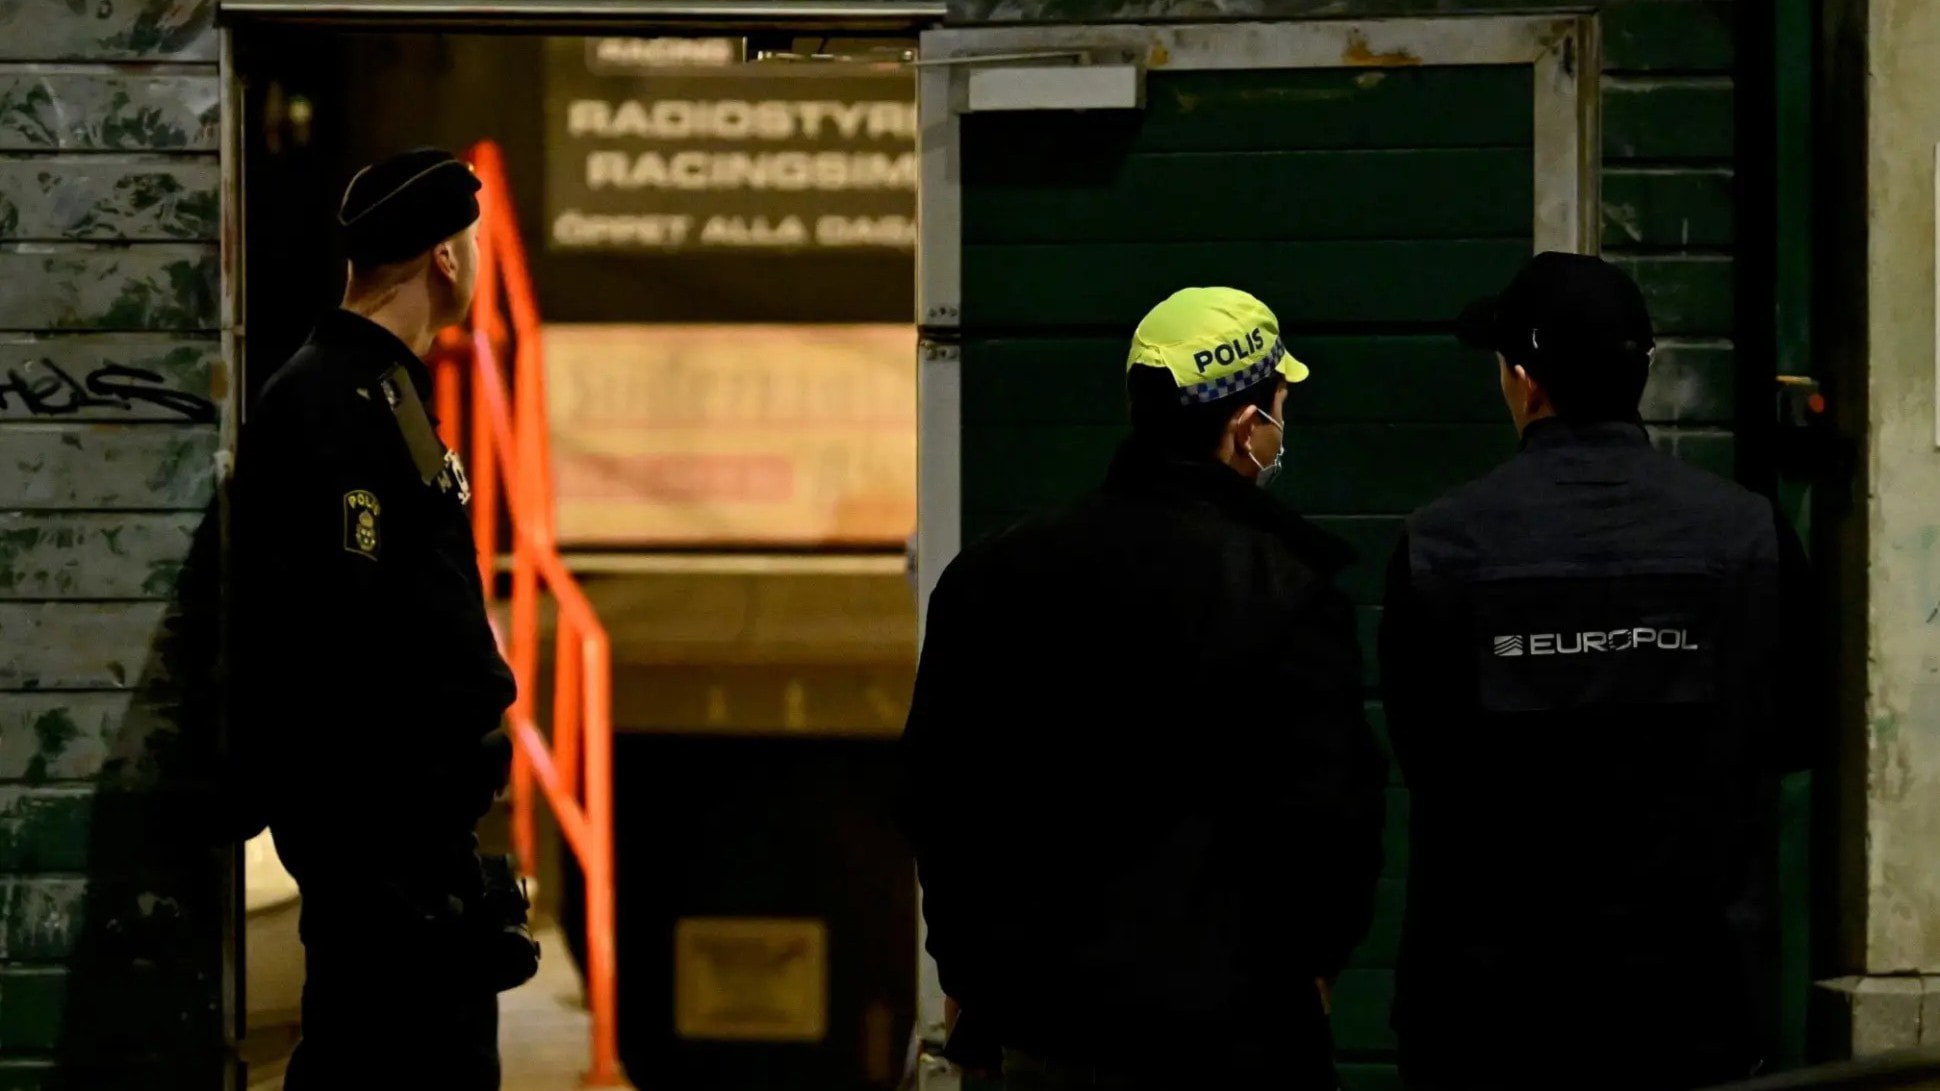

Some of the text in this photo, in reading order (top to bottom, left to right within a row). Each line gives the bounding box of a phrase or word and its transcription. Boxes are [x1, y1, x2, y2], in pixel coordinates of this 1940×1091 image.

[701, 213, 807, 246] ALLA
[1193, 328, 1264, 373] POLIS
[1530, 627, 1699, 655] EUROPOL
